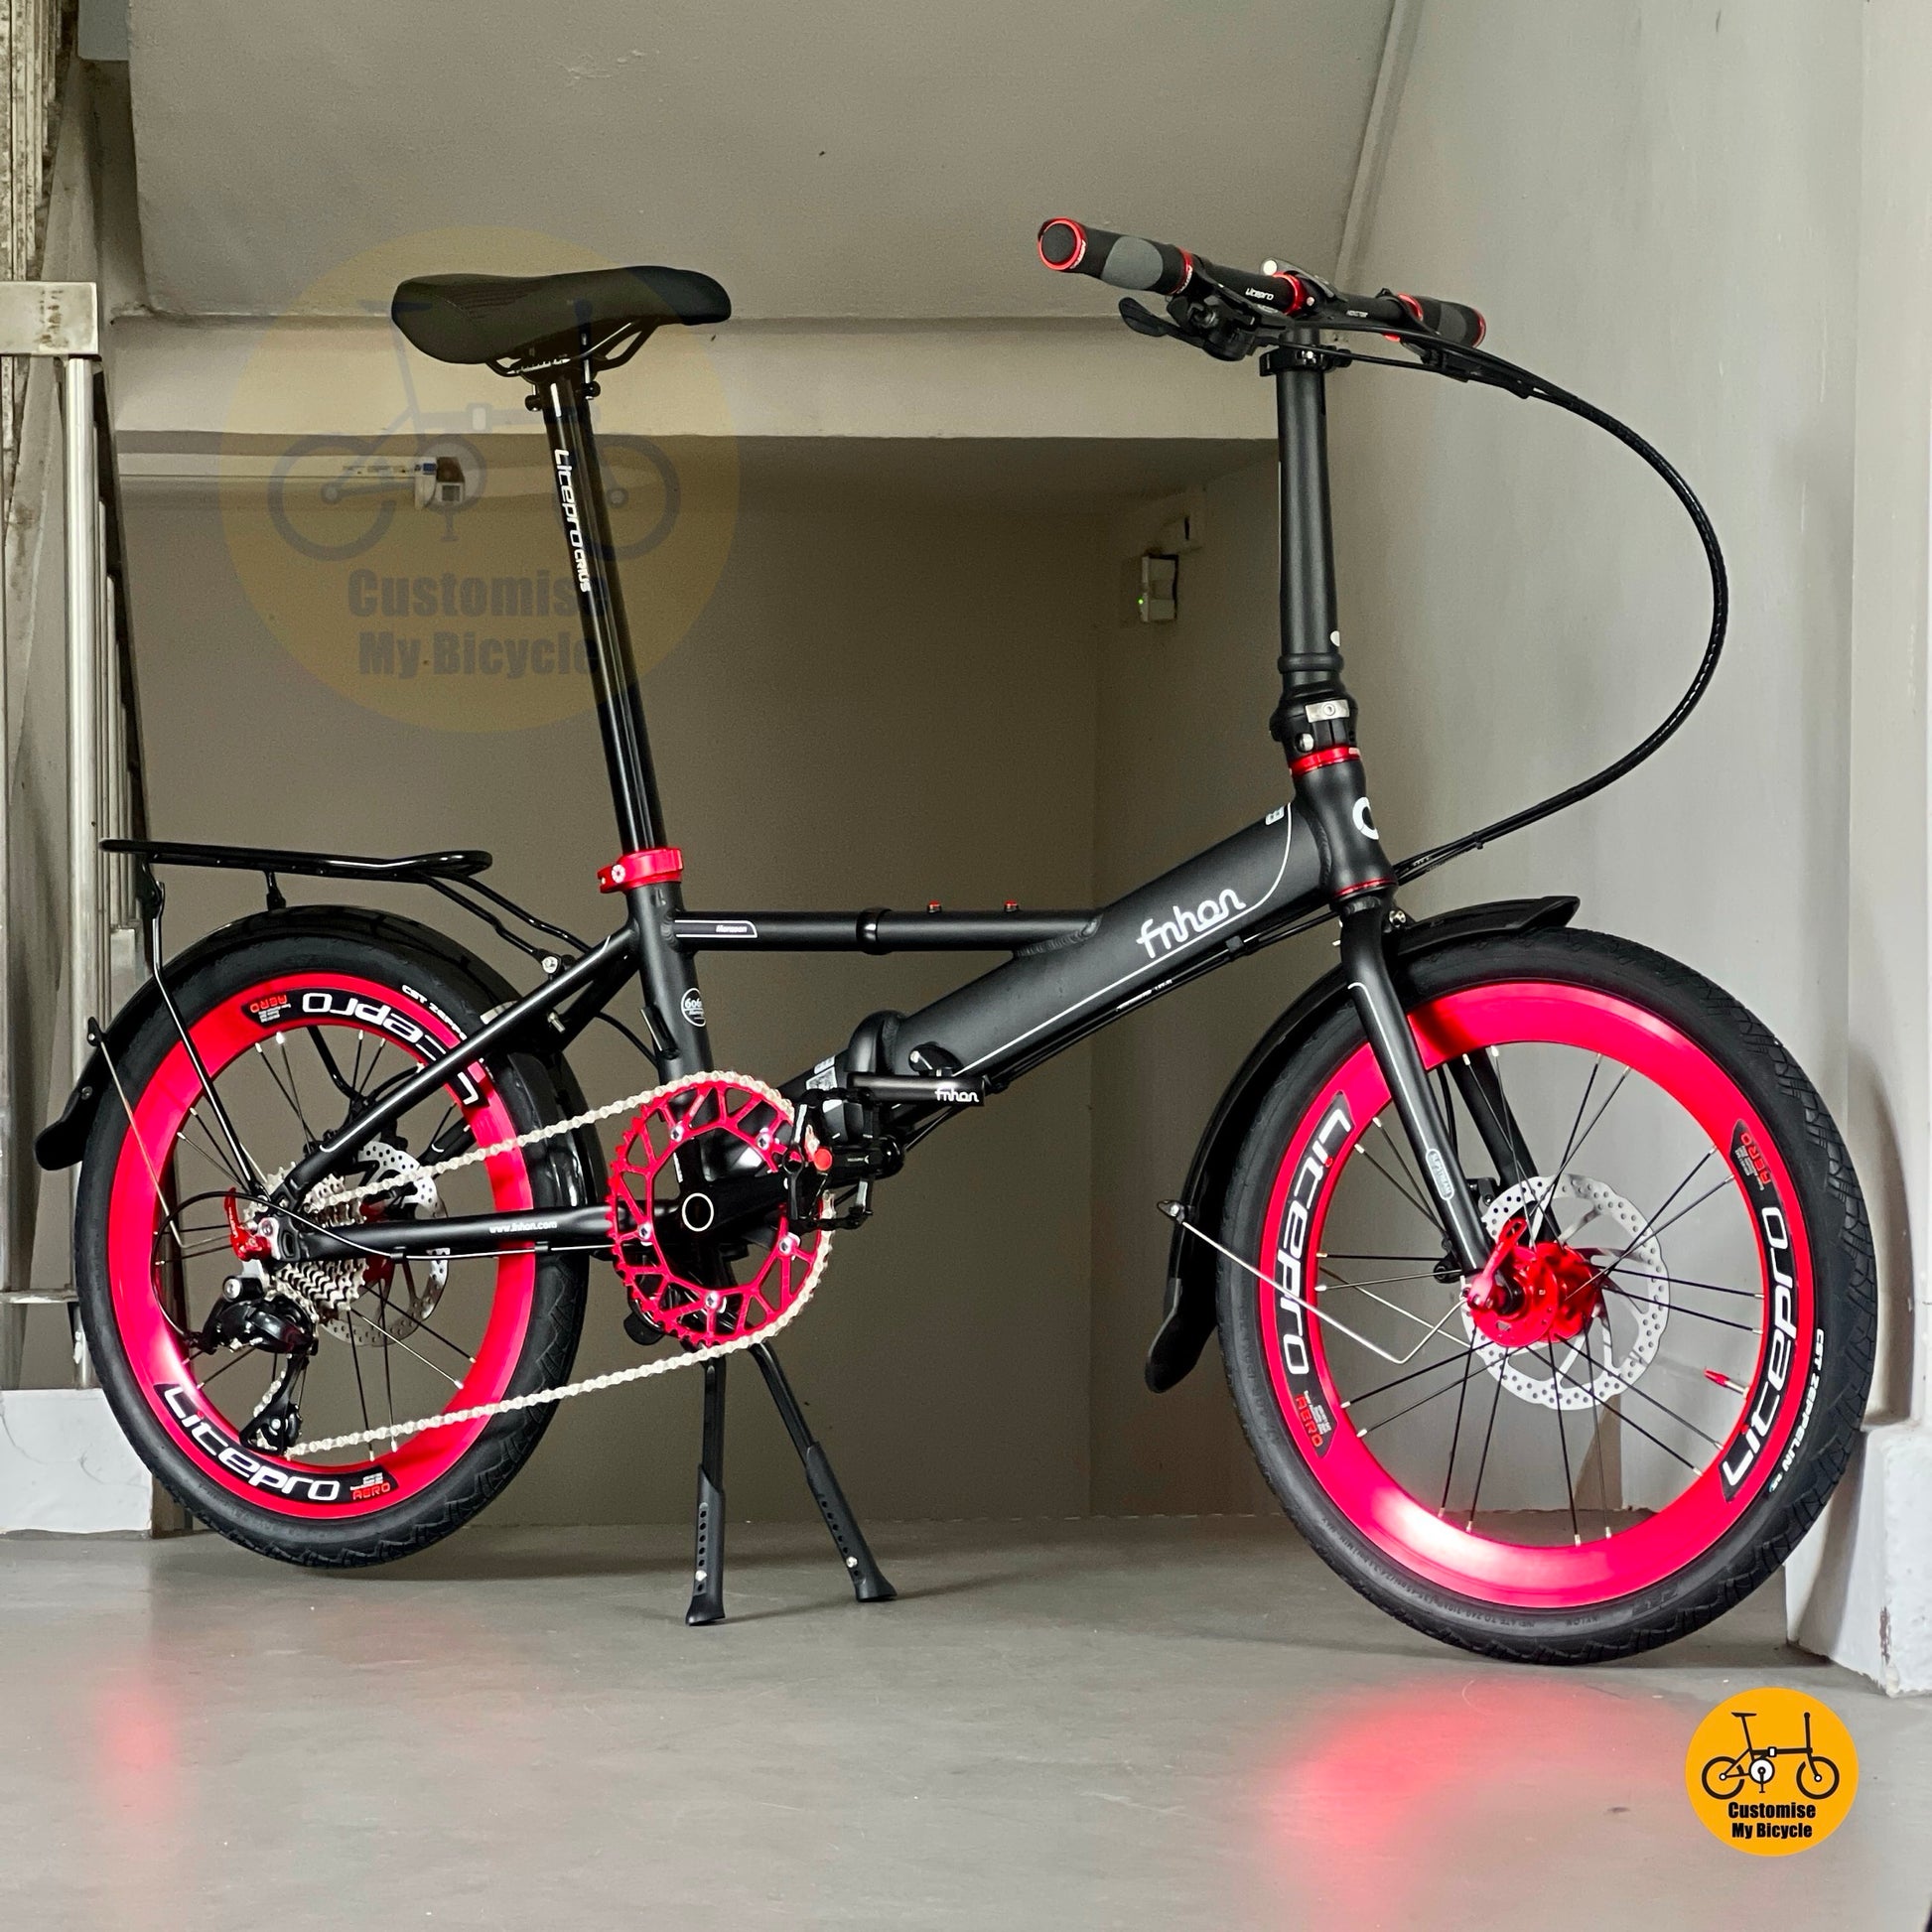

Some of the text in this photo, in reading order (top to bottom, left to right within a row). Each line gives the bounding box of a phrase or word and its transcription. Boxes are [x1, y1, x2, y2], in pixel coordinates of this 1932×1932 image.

[1136, 889, 1247, 959] fnhon
[249, 994, 288, 1014] AERO
[402, 984, 428, 1004] CST
[934, 1087, 980, 1103] fnhon
[1739, 1131, 1773, 1189] AERO
[488, 1221, 558, 1233] www.fnhon.com
[1782, 1328, 1826, 1473] CST ZEPPELIN
[1295, 1394, 1323, 1449] AERO
[352, 1481, 391, 1500] AERO
